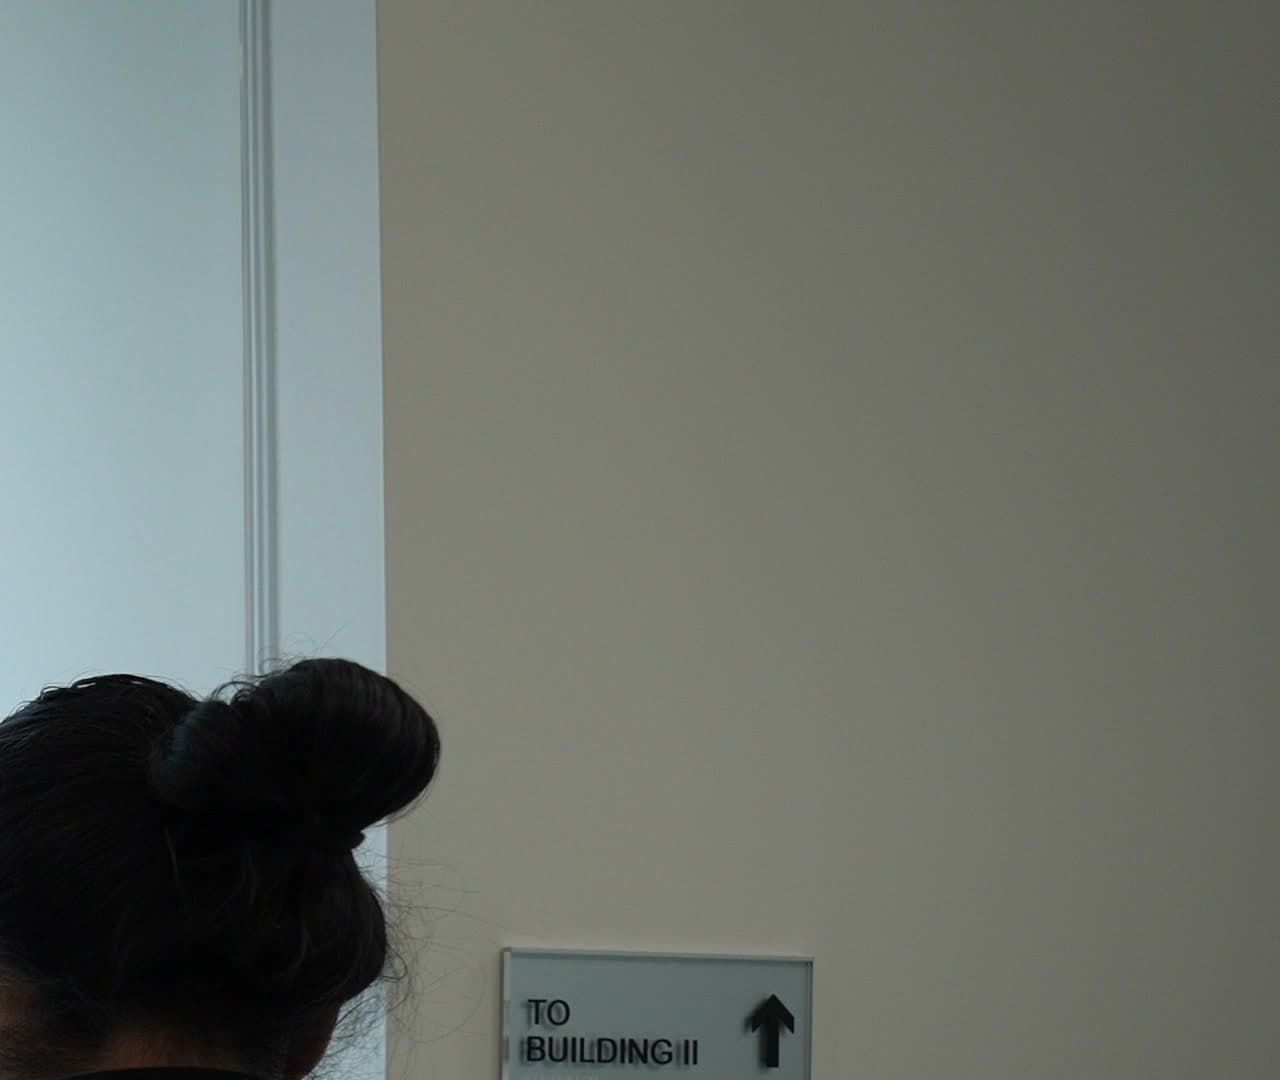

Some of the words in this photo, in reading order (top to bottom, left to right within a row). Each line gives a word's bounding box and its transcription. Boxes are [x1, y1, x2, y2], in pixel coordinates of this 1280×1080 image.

[526, 998, 571, 1026] TO
[525, 1035, 673, 1065] BUILDING
[683, 1039, 699, 1065] II
